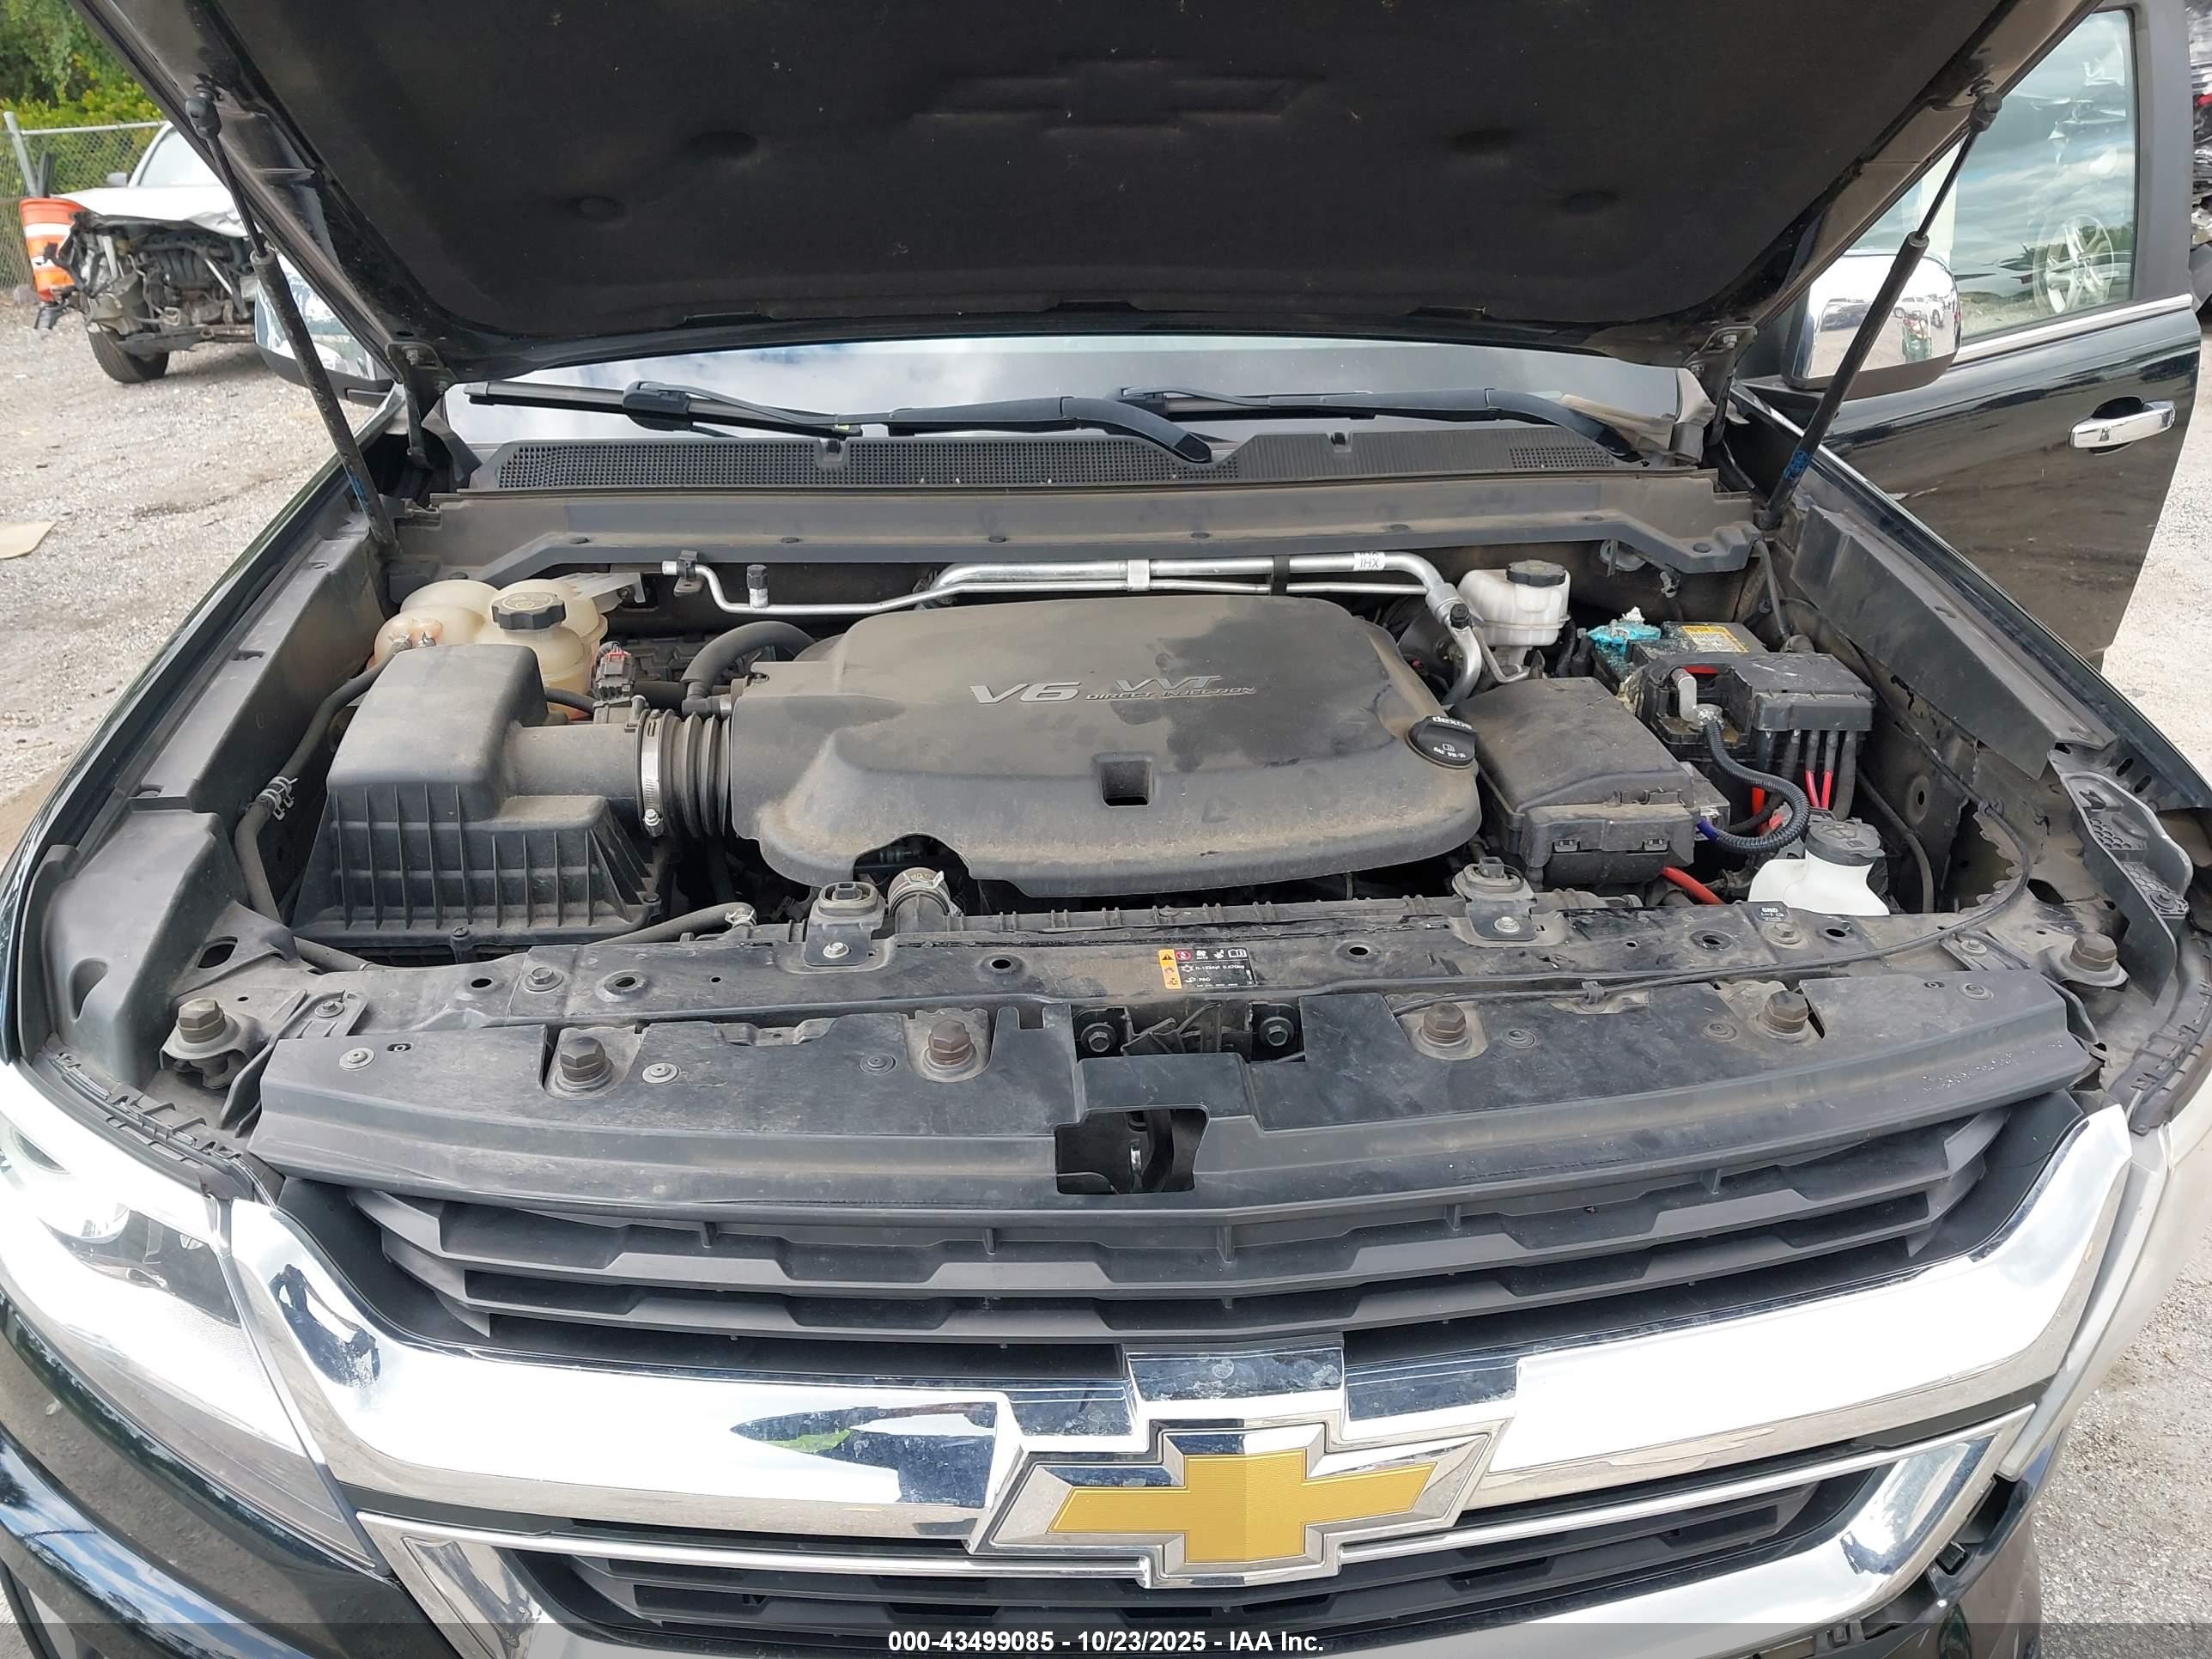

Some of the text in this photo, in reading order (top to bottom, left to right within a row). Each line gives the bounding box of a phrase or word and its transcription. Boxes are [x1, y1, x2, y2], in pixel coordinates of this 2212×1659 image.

[969, 676, 1223, 705] V6 VVT
[1085, 686, 1257, 702] DIRECT INJECTION
